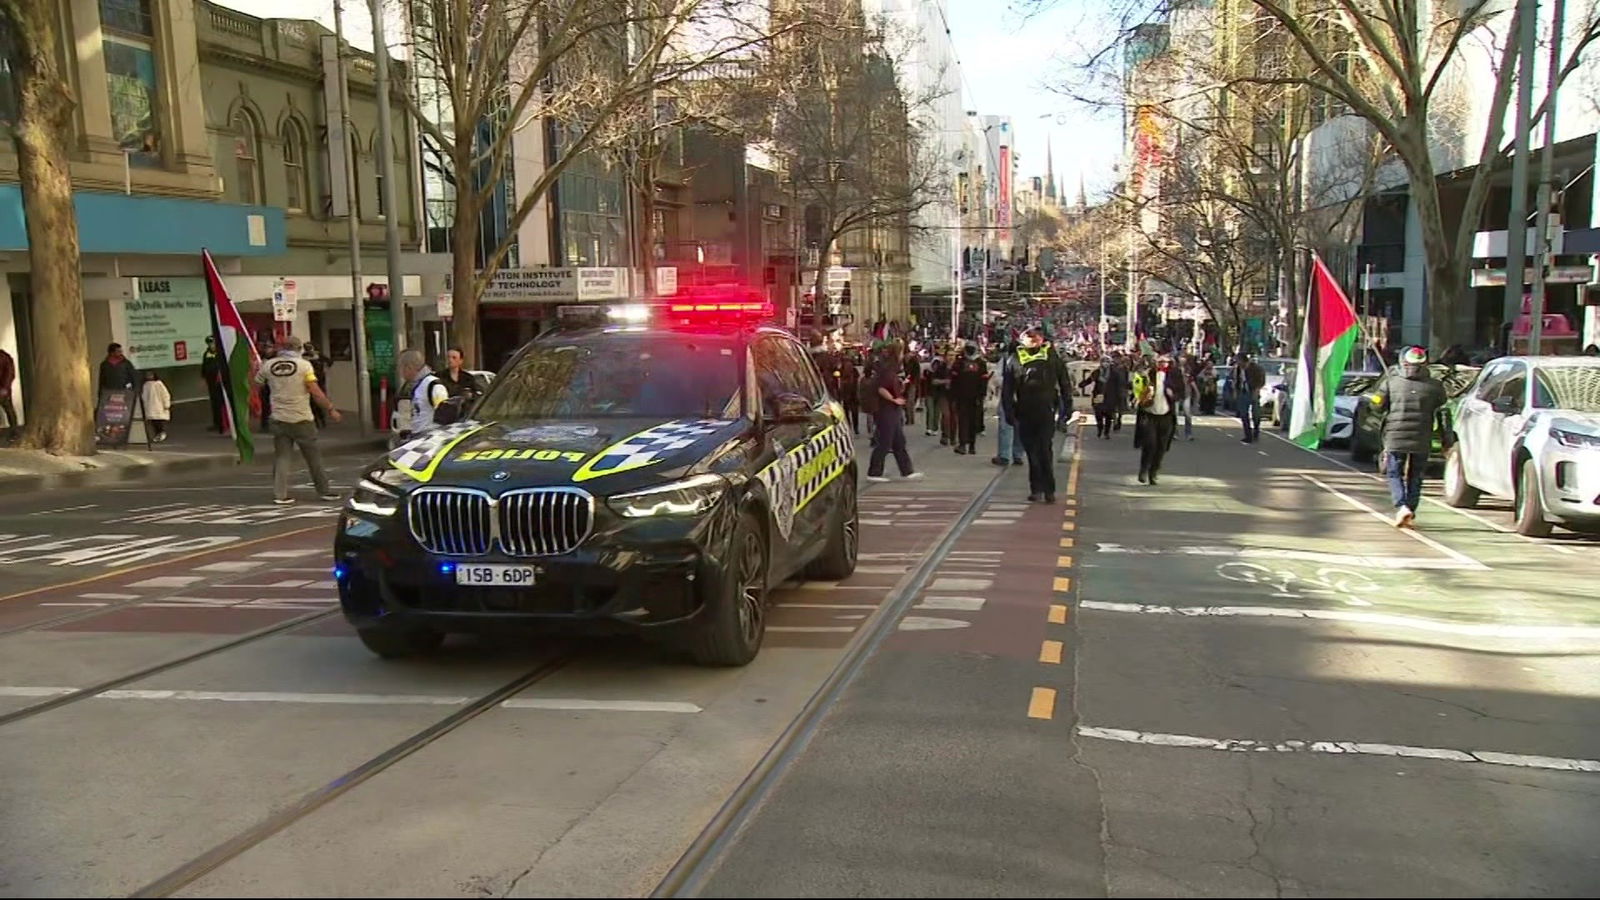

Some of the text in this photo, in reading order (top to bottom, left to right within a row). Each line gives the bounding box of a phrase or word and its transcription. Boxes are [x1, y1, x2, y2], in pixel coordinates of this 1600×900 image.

[522, 271, 572, 279] INSTITUTE
[144, 281, 170, 293] LEASE
[499, 281, 561, 289] TECHNOLOGY
[0, 534, 242, 567] EAR
